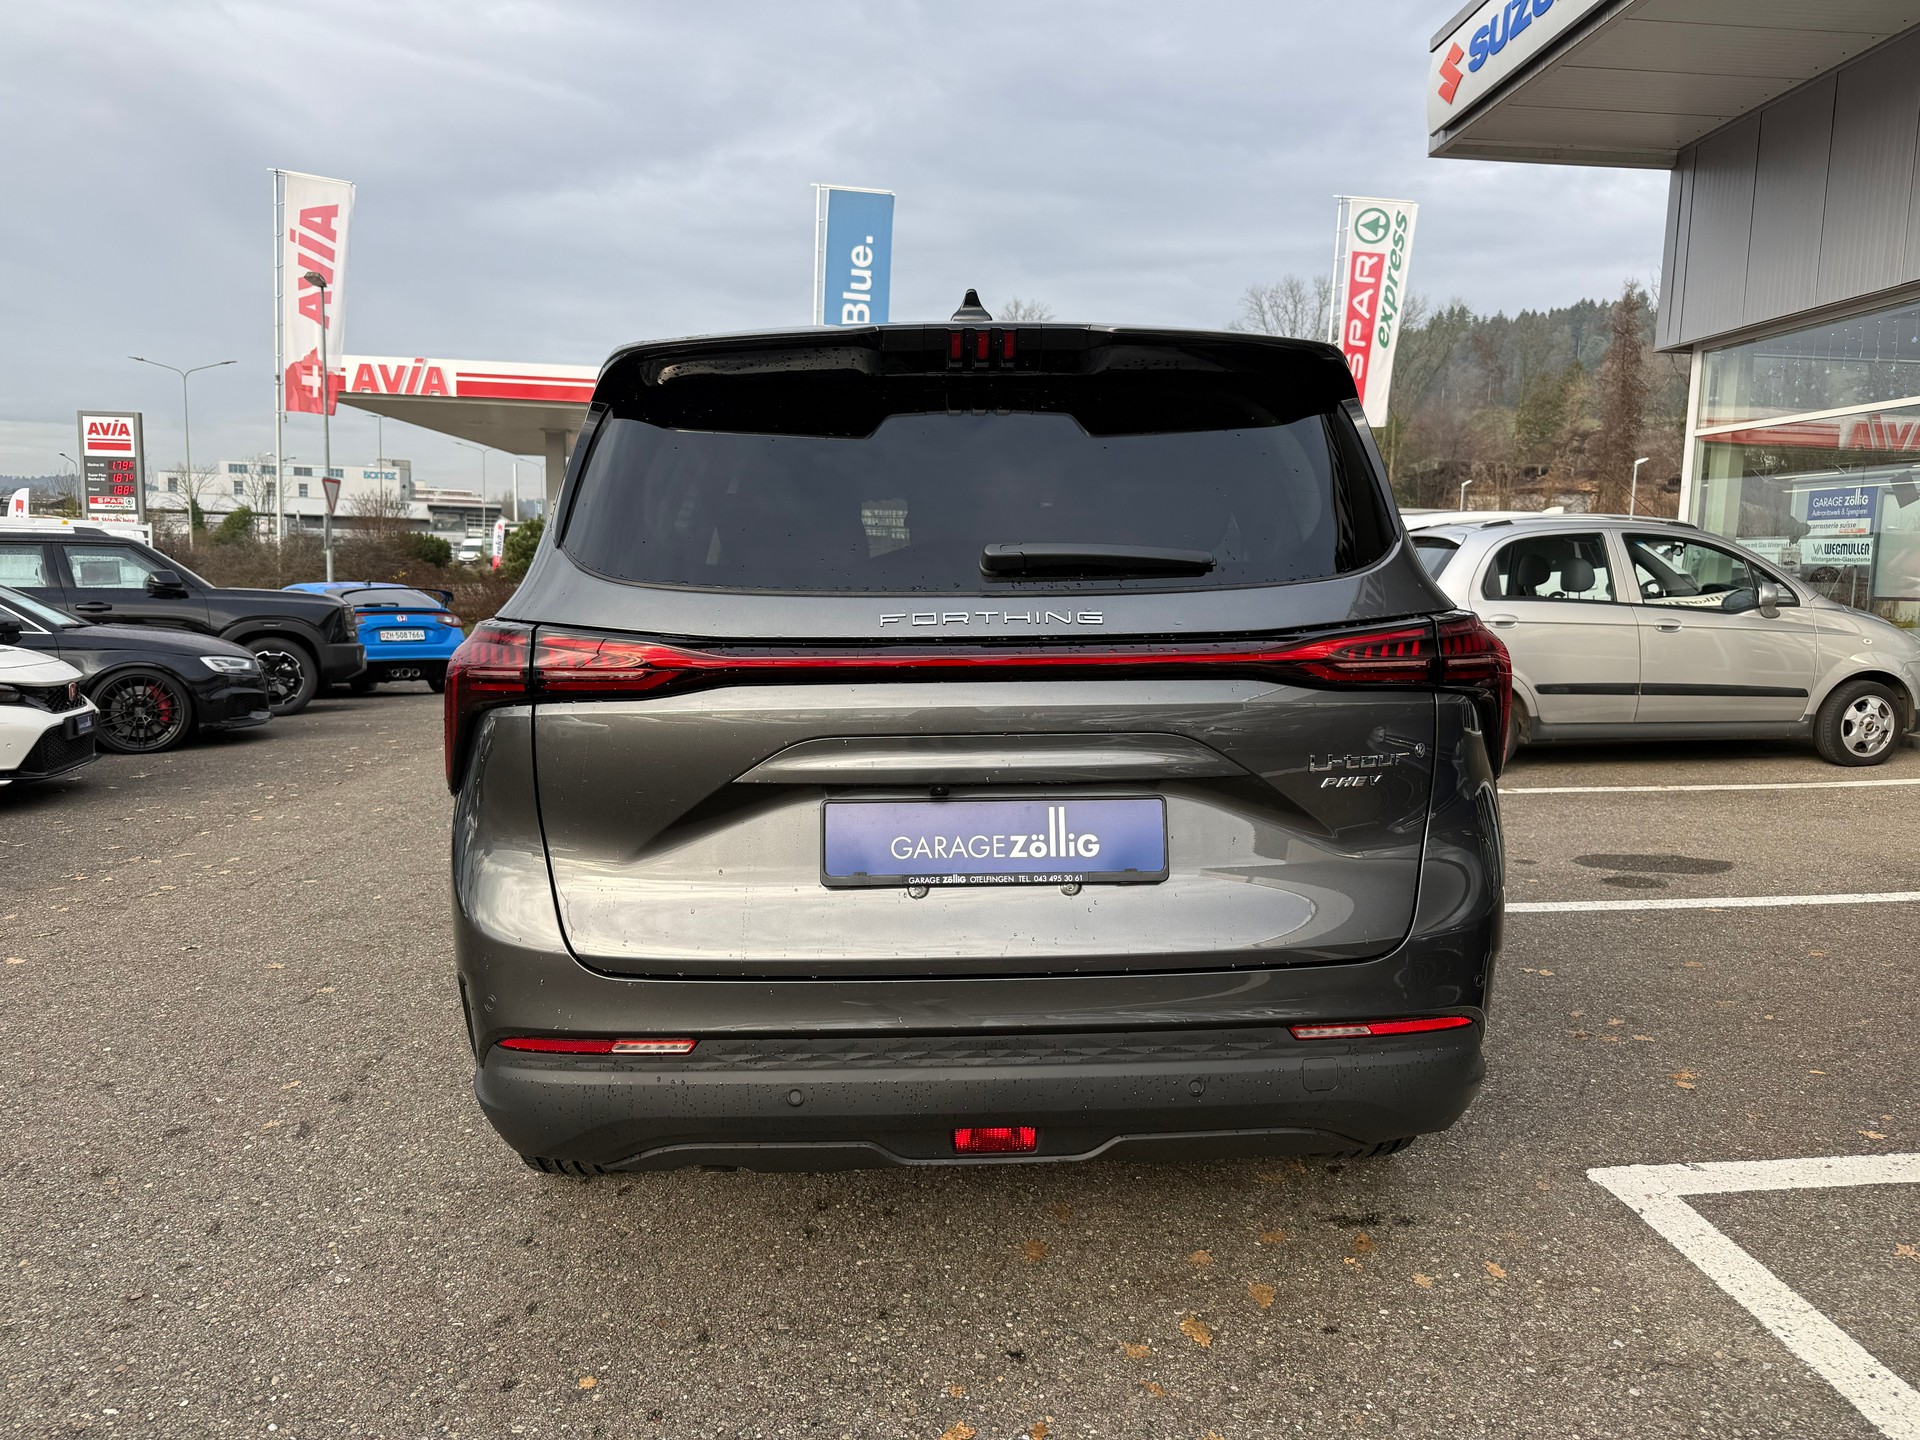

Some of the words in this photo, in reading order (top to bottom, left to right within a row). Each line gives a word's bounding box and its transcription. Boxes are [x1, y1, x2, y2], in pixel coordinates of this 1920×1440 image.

[841, 235, 874, 325] Blue.
[1377, 209, 1408, 349] express
[1348, 254, 1379, 380] SPAR
[351, 357, 450, 397] AVIA
[87, 419, 131, 436] AVIA
[1812, 496, 1844, 508] GARAGE
[879, 611, 1104, 627] FORTHING
[1320, 773, 1383, 788] PHEV
[891, 835, 1005, 860] GARAGE
[908, 876, 941, 885] GARAGE
[969, 875, 1015, 883] OTELFINGEN
[1033, 874, 1048, 882] 043
[1049, 874, 1062, 882] 495
[1063, 874, 1074, 882] 30
[1074, 874, 1083, 882] 61
